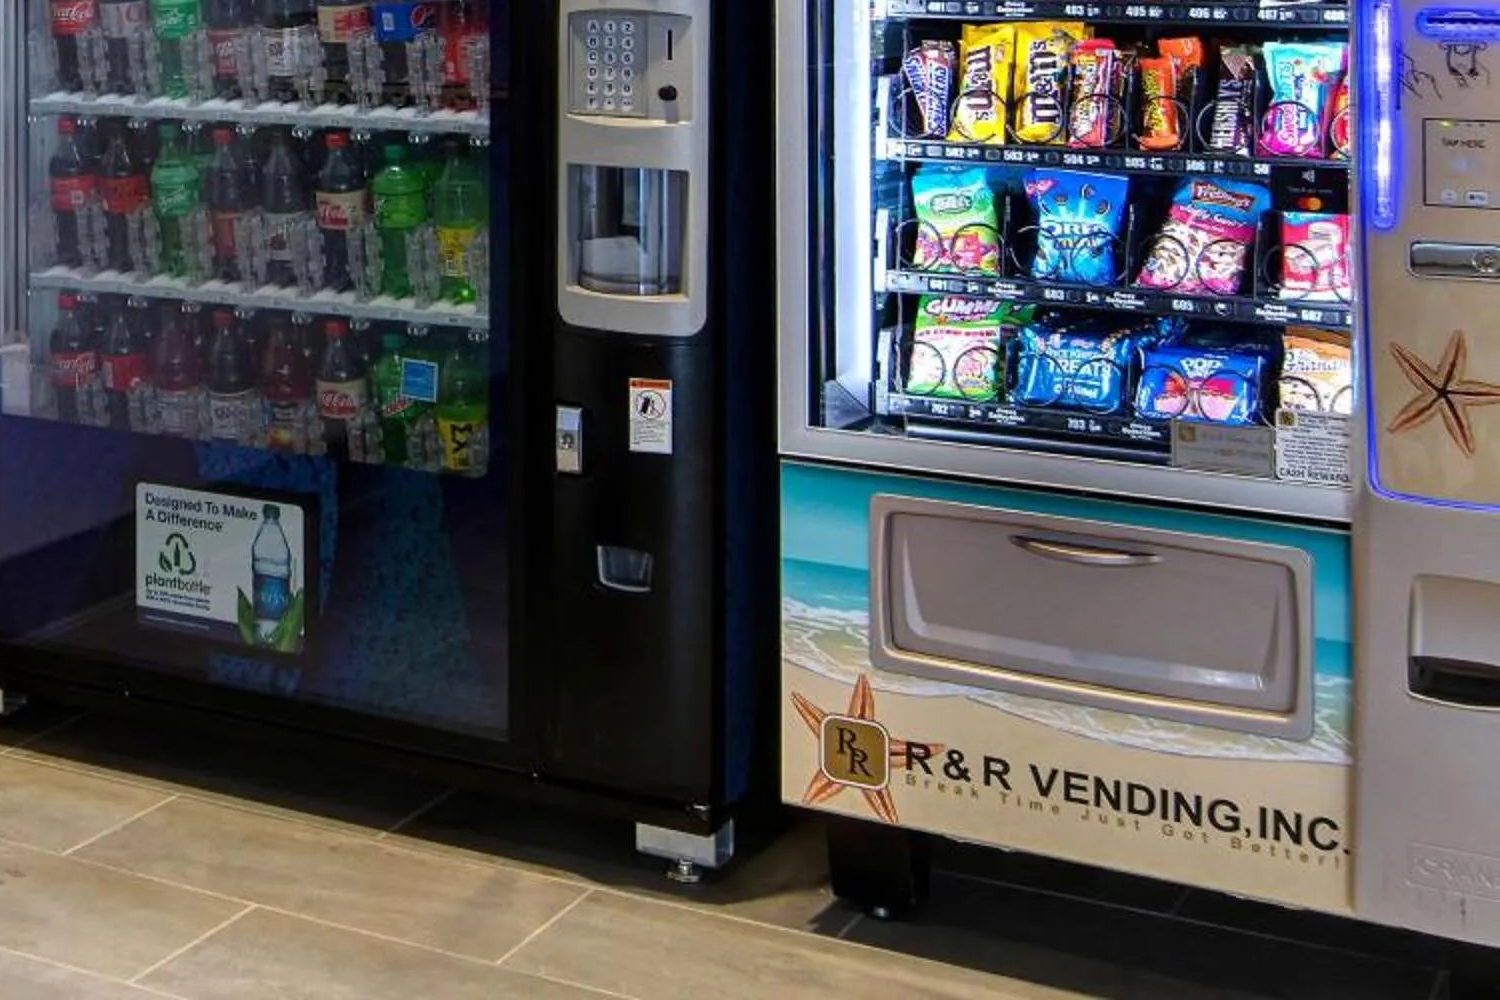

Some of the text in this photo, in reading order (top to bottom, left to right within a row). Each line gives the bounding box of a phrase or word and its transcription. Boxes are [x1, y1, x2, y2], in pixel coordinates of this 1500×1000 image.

[145, 492, 258, 521] Designed To Make
[145, 510, 224, 532] A Difference
[145, 572, 211, 595] plantbottle
[905, 740, 934, 776] R
[943, 749, 971, 783] &
[983, 755, 1013, 791] R
[906, 773, 979, 800] Break
[1000, 792, 1060, 815] Time
[1081, 809, 1141, 832] Just
[1161, 823, 1209, 844] Got
